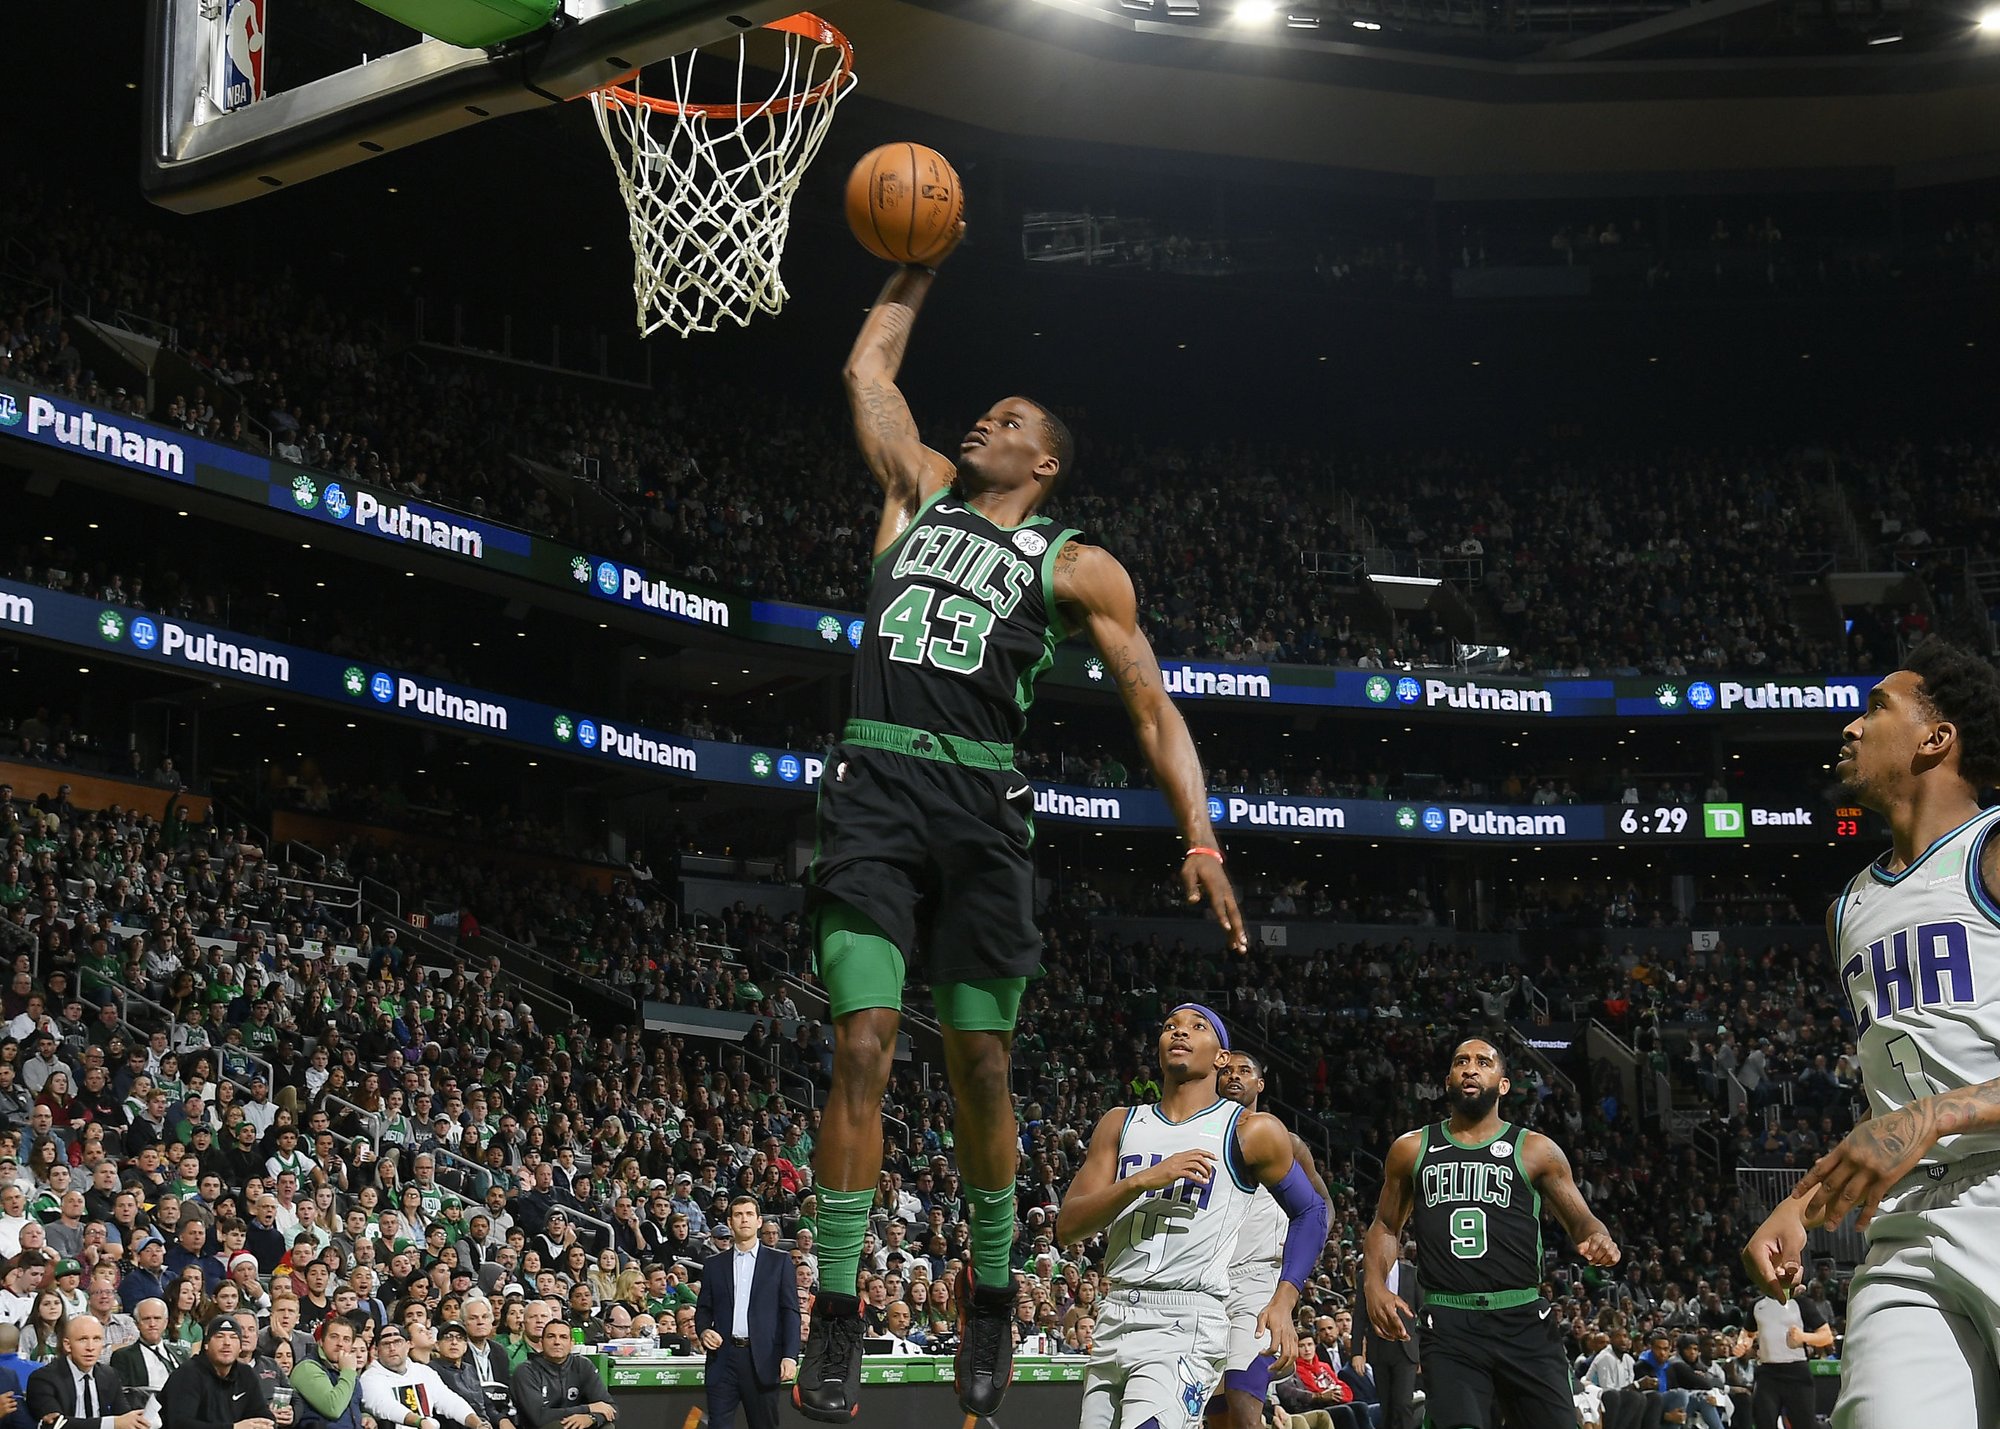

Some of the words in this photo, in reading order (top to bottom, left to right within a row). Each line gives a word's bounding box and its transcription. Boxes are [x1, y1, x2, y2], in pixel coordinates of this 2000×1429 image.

[227, 82, 247, 108] NBA
[27, 395, 184, 475] Putnam
[355, 491, 483, 559] Putnam
[891, 525, 1035, 619] CELTICS
[622, 568, 729, 627] Putnam
[878, 584, 996, 675] 43
[162, 622, 289, 682] Putnam
[1161, 665, 1271, 698] utnam
[1425, 679, 1552, 712] Putnam
[1719, 682, 1860, 709] Putnam
[398, 678, 507, 730] Putnam
[601, 724, 697, 772] Putnam
[1033, 788, 1120, 819] utnam
[1229, 799, 1345, 829] Putnam
[1707, 809, 1741, 831] TD
[1751, 807, 1812, 826] Bank
[1449, 808, 1566, 835] Putnam
[1620, 807, 1688, 834] 6:29
[1837, 821, 1857, 835] 23
[411, 914, 425, 929] EXIT
[1270, 928, 1278, 942] 4
[1702, 934, 1710, 948] 5
[1841, 919, 1977, 1041] CHA
[1422, 1161, 1514, 1208] CELTICS
[1129, 1210, 1172, 1274] 4
[1450, 1207, 1487, 1259] 9
